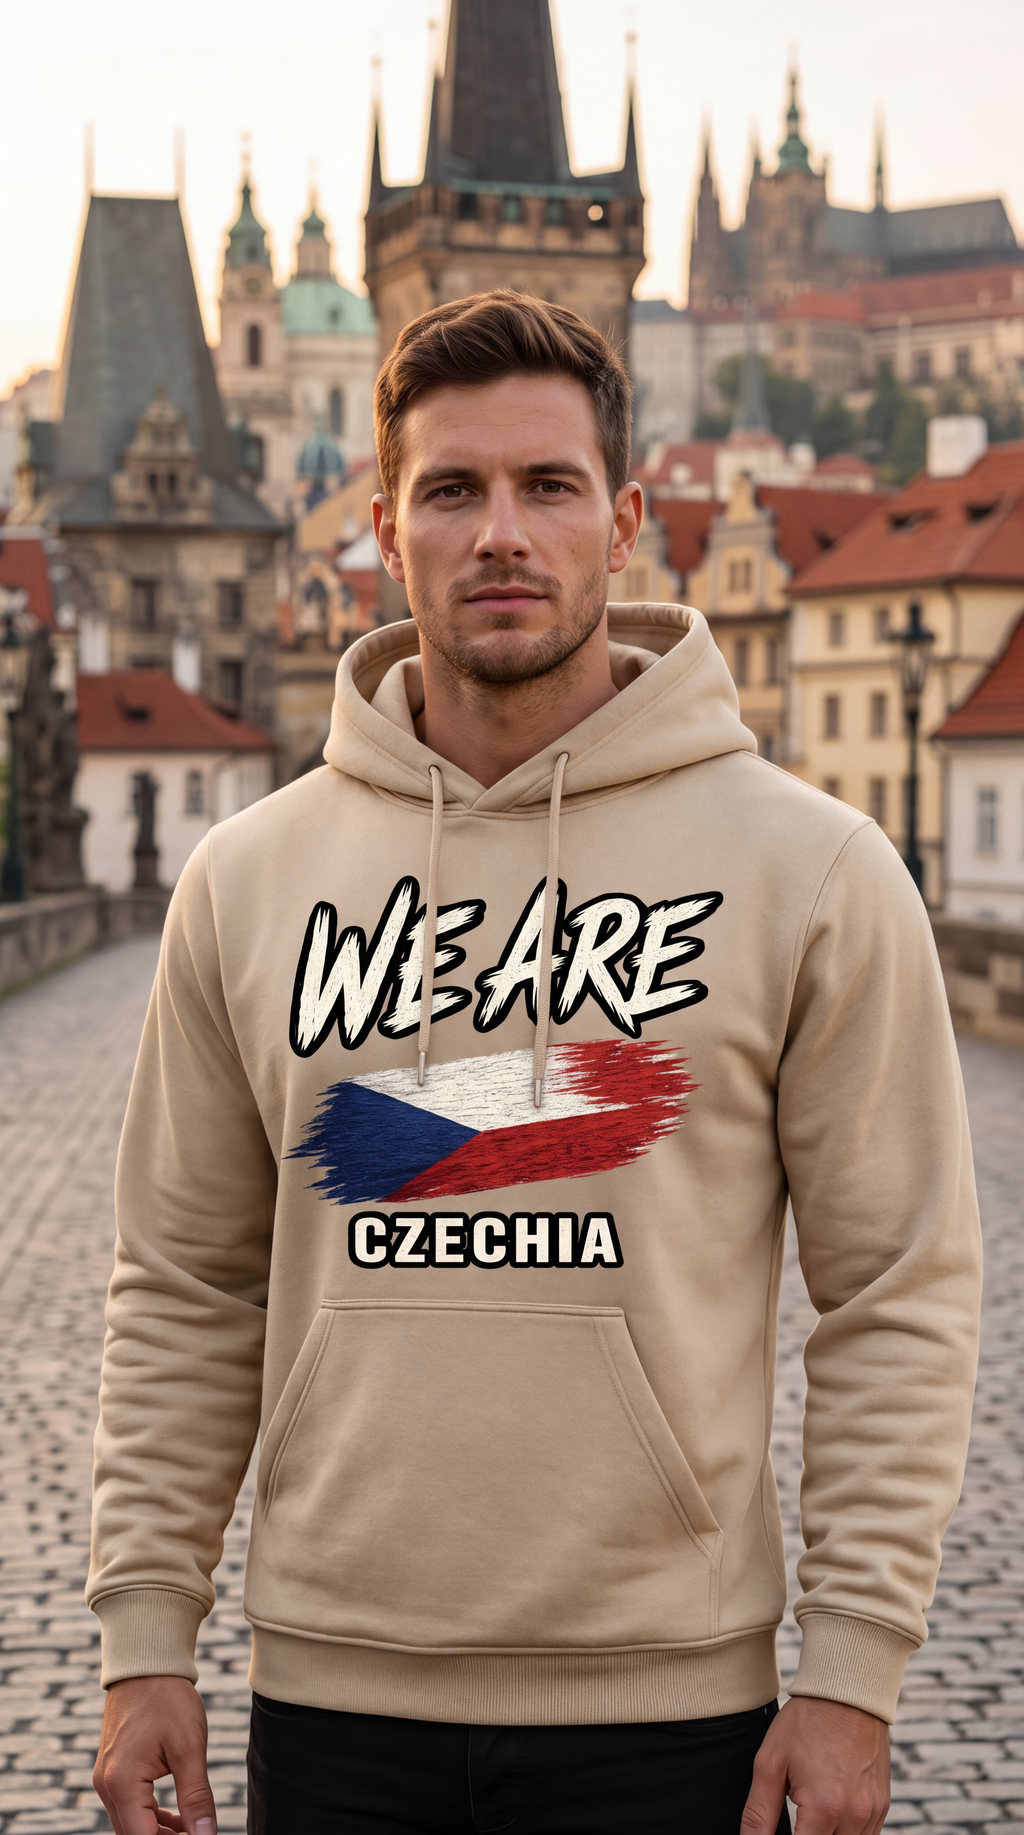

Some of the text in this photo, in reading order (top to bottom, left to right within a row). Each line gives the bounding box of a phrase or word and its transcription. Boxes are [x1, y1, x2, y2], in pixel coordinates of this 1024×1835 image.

[290, 876, 723, 1058] WE ARE
[348, 1211, 624, 1269] CZECHIA
